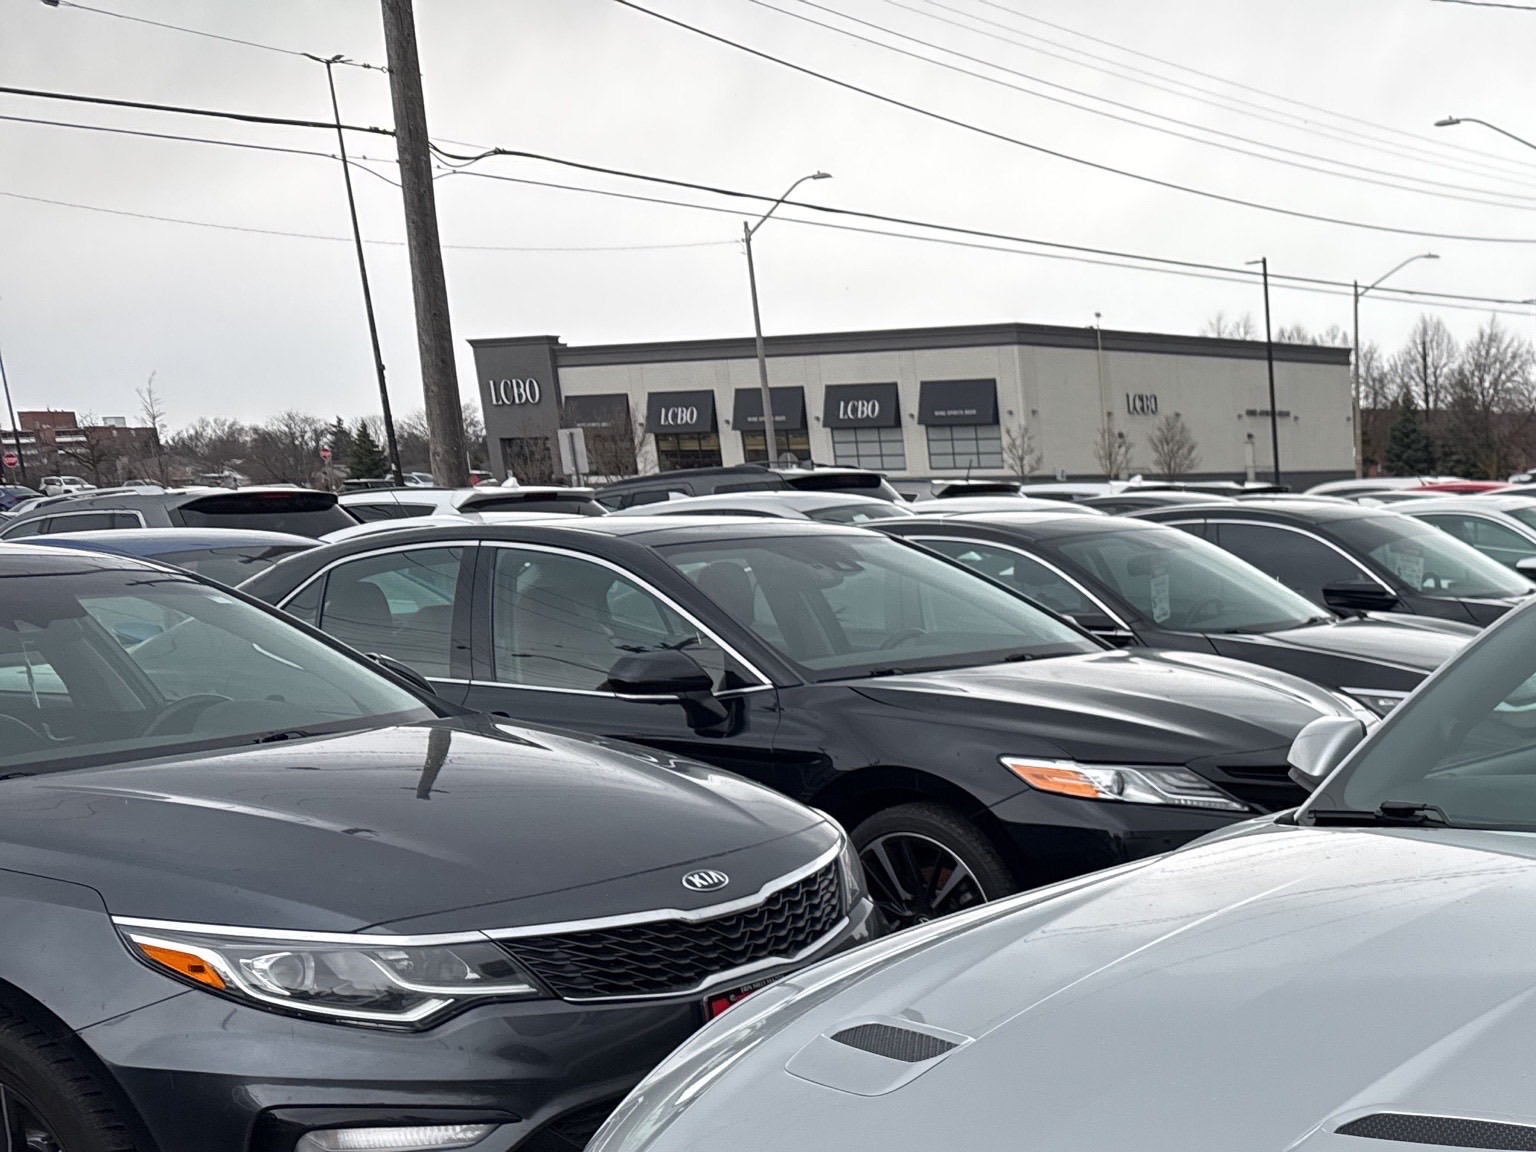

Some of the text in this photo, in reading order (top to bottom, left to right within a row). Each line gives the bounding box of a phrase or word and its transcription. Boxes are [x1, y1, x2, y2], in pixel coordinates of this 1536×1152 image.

[488, 377, 541, 406] LCBO
[660, 406, 698, 426] LCBO
[838, 400, 880, 420] LCBO
[688, 870, 725, 888] KIA
